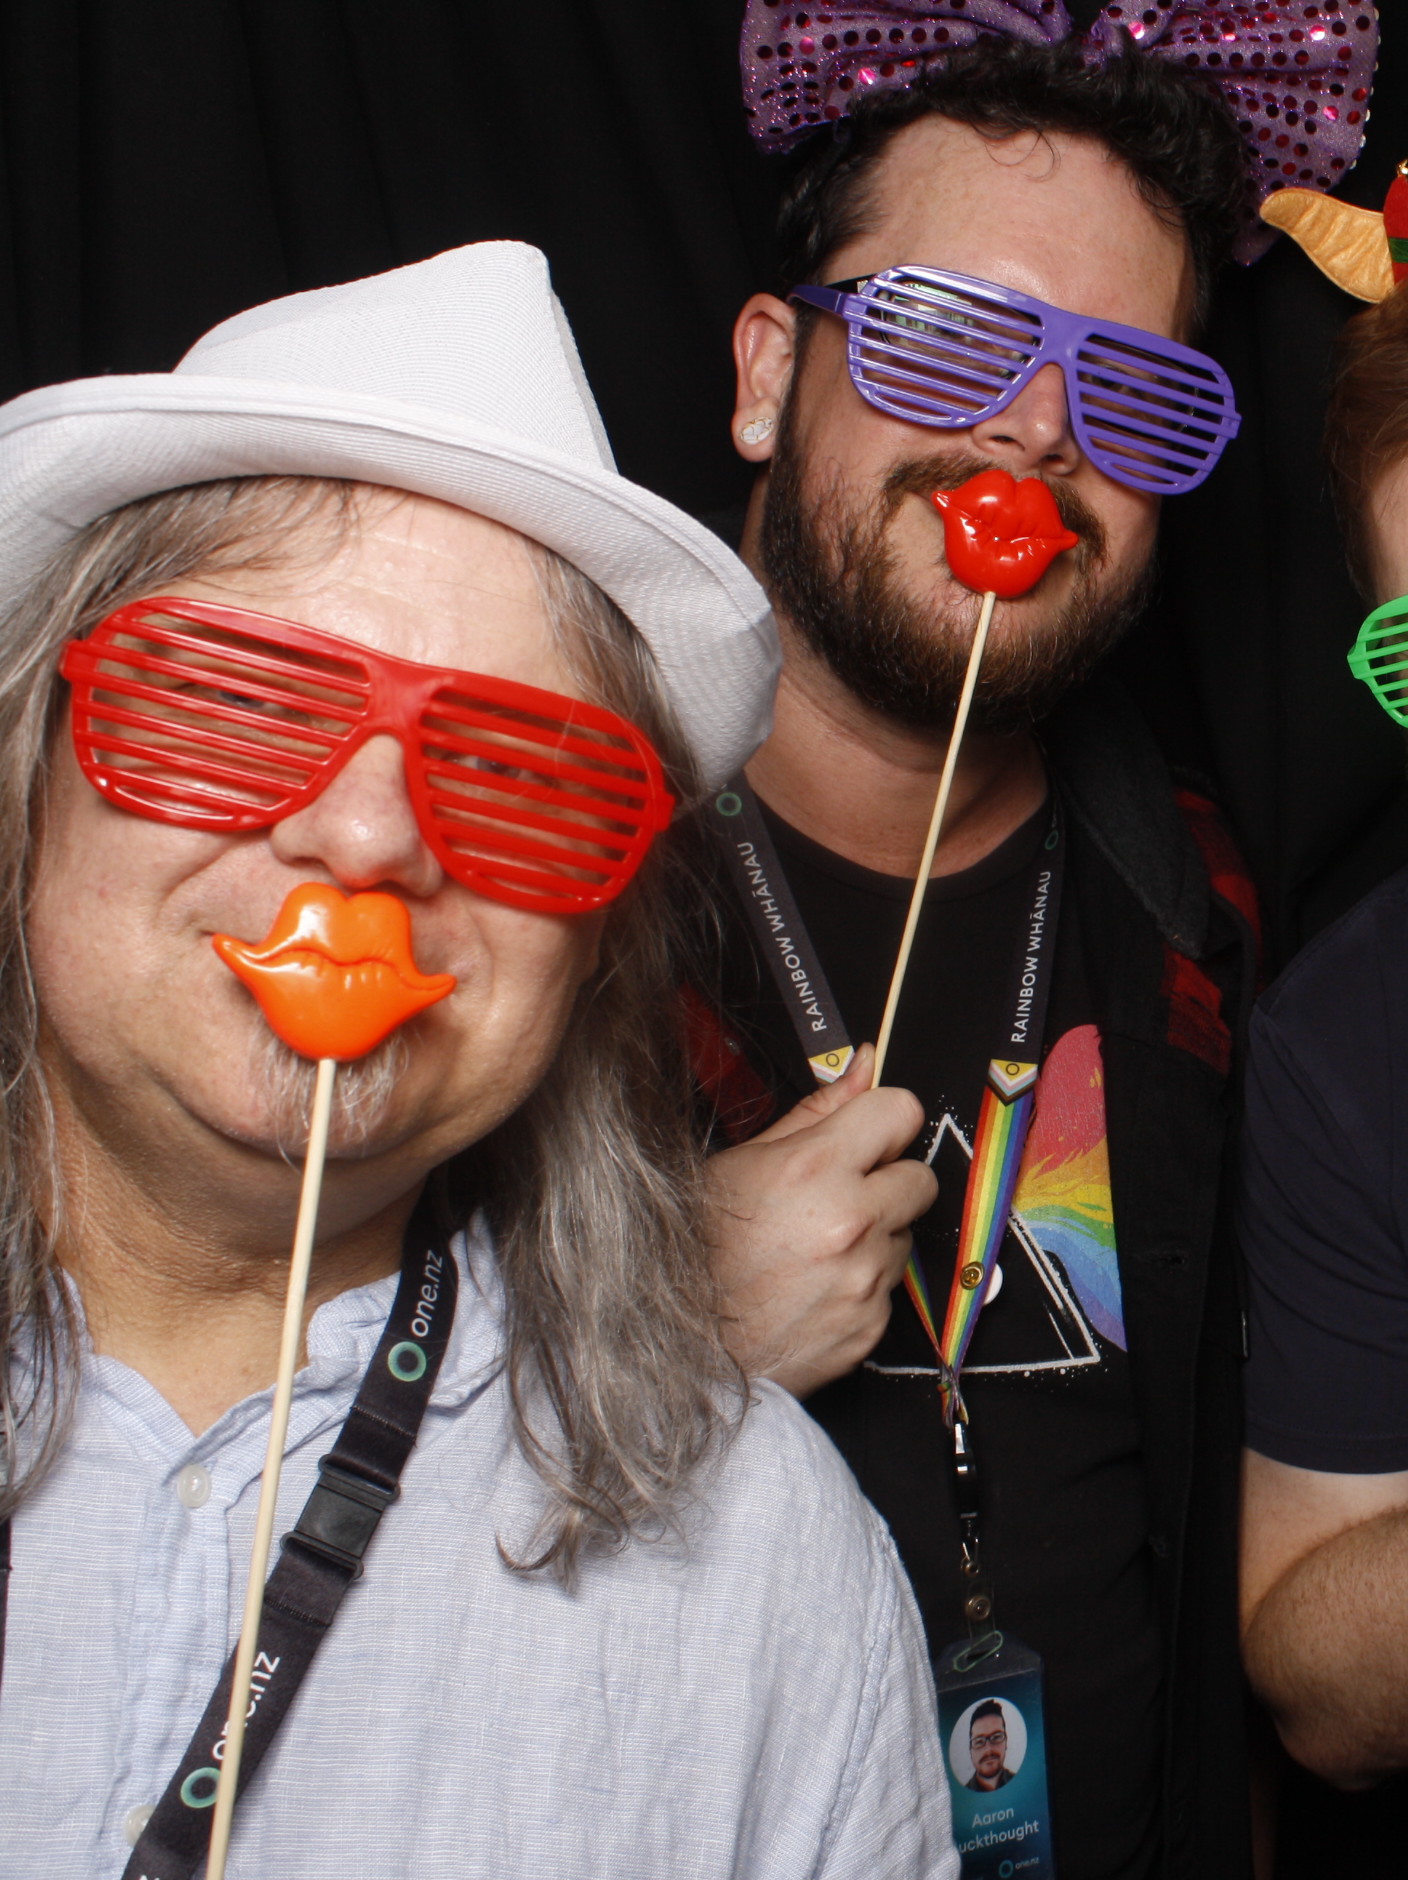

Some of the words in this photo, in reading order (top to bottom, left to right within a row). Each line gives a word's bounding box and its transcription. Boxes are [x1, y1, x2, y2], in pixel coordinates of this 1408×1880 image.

[737, 842, 785, 932] WHĀNAU
[775, 936, 827, 1032] RAINBOW
[1011, 956, 1039, 1043] RAINBOW
[1026, 871, 1051, 952] WHĀNAU
[411, 1249, 443, 1338] one.nz
[958, 1819, 1040, 1854] uckthought
[971, 1807, 1014, 1829] Aaron
[1014, 1856, 1040, 1870] one.nz
